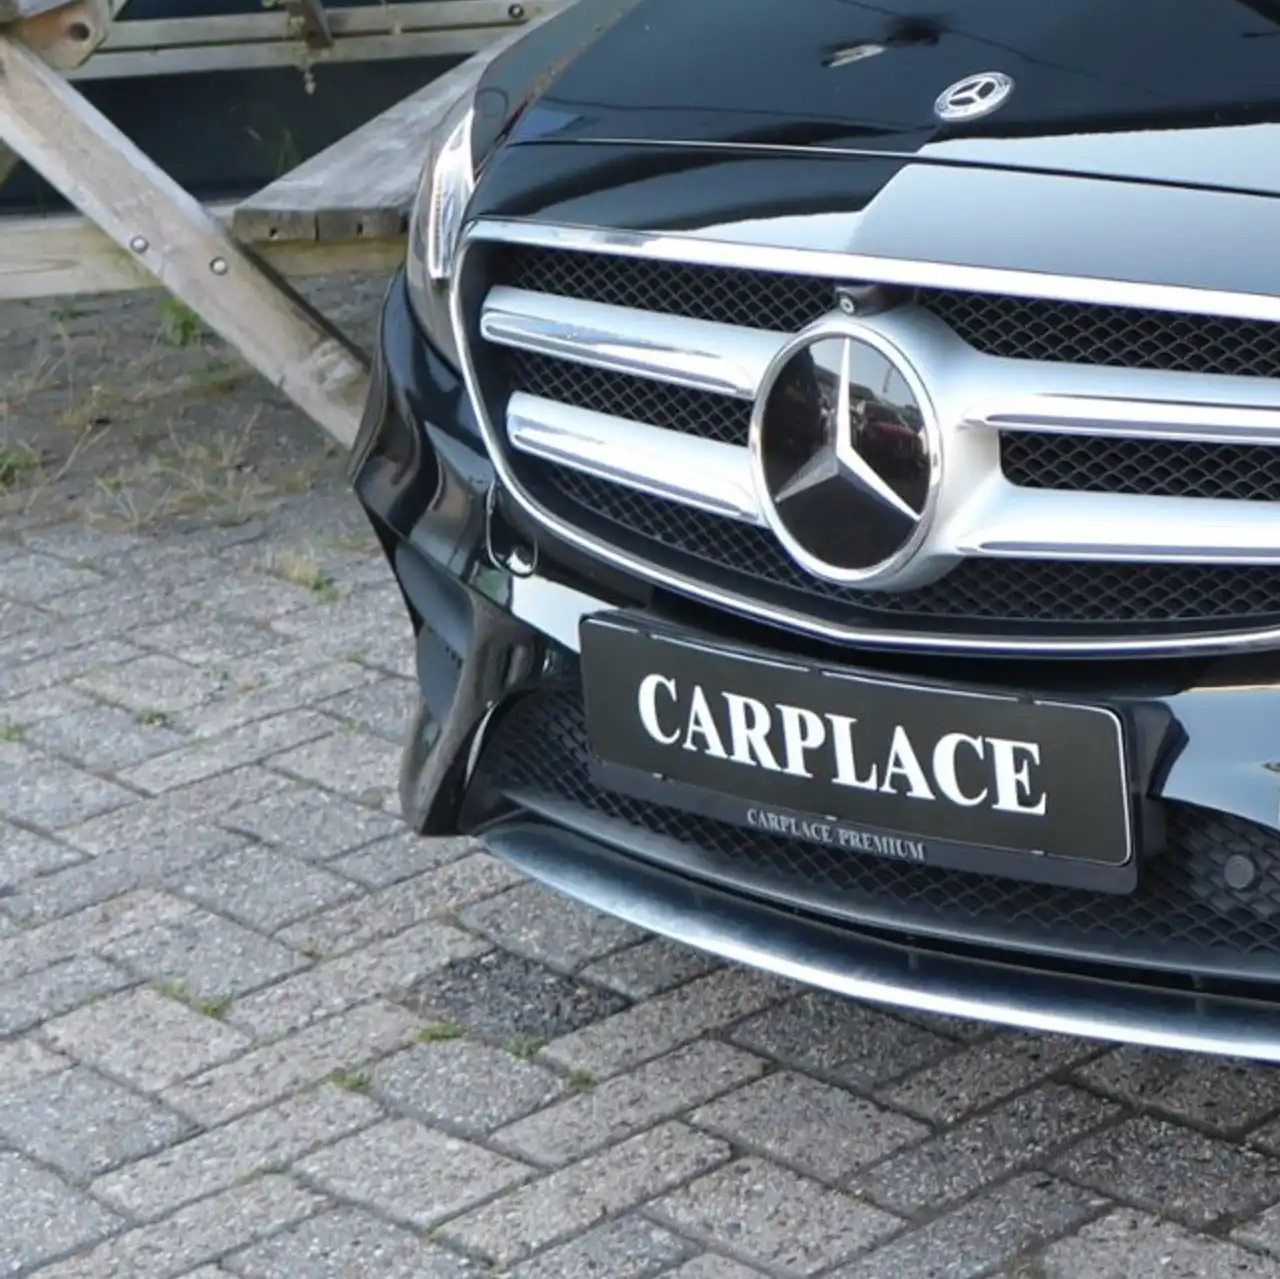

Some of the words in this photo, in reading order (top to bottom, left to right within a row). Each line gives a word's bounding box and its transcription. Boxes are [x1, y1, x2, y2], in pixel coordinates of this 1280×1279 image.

[638, 673, 1047, 816] CARPLACE
[746, 807, 834, 843] CARPLACE
[837, 827, 926, 861] PREMIUM
